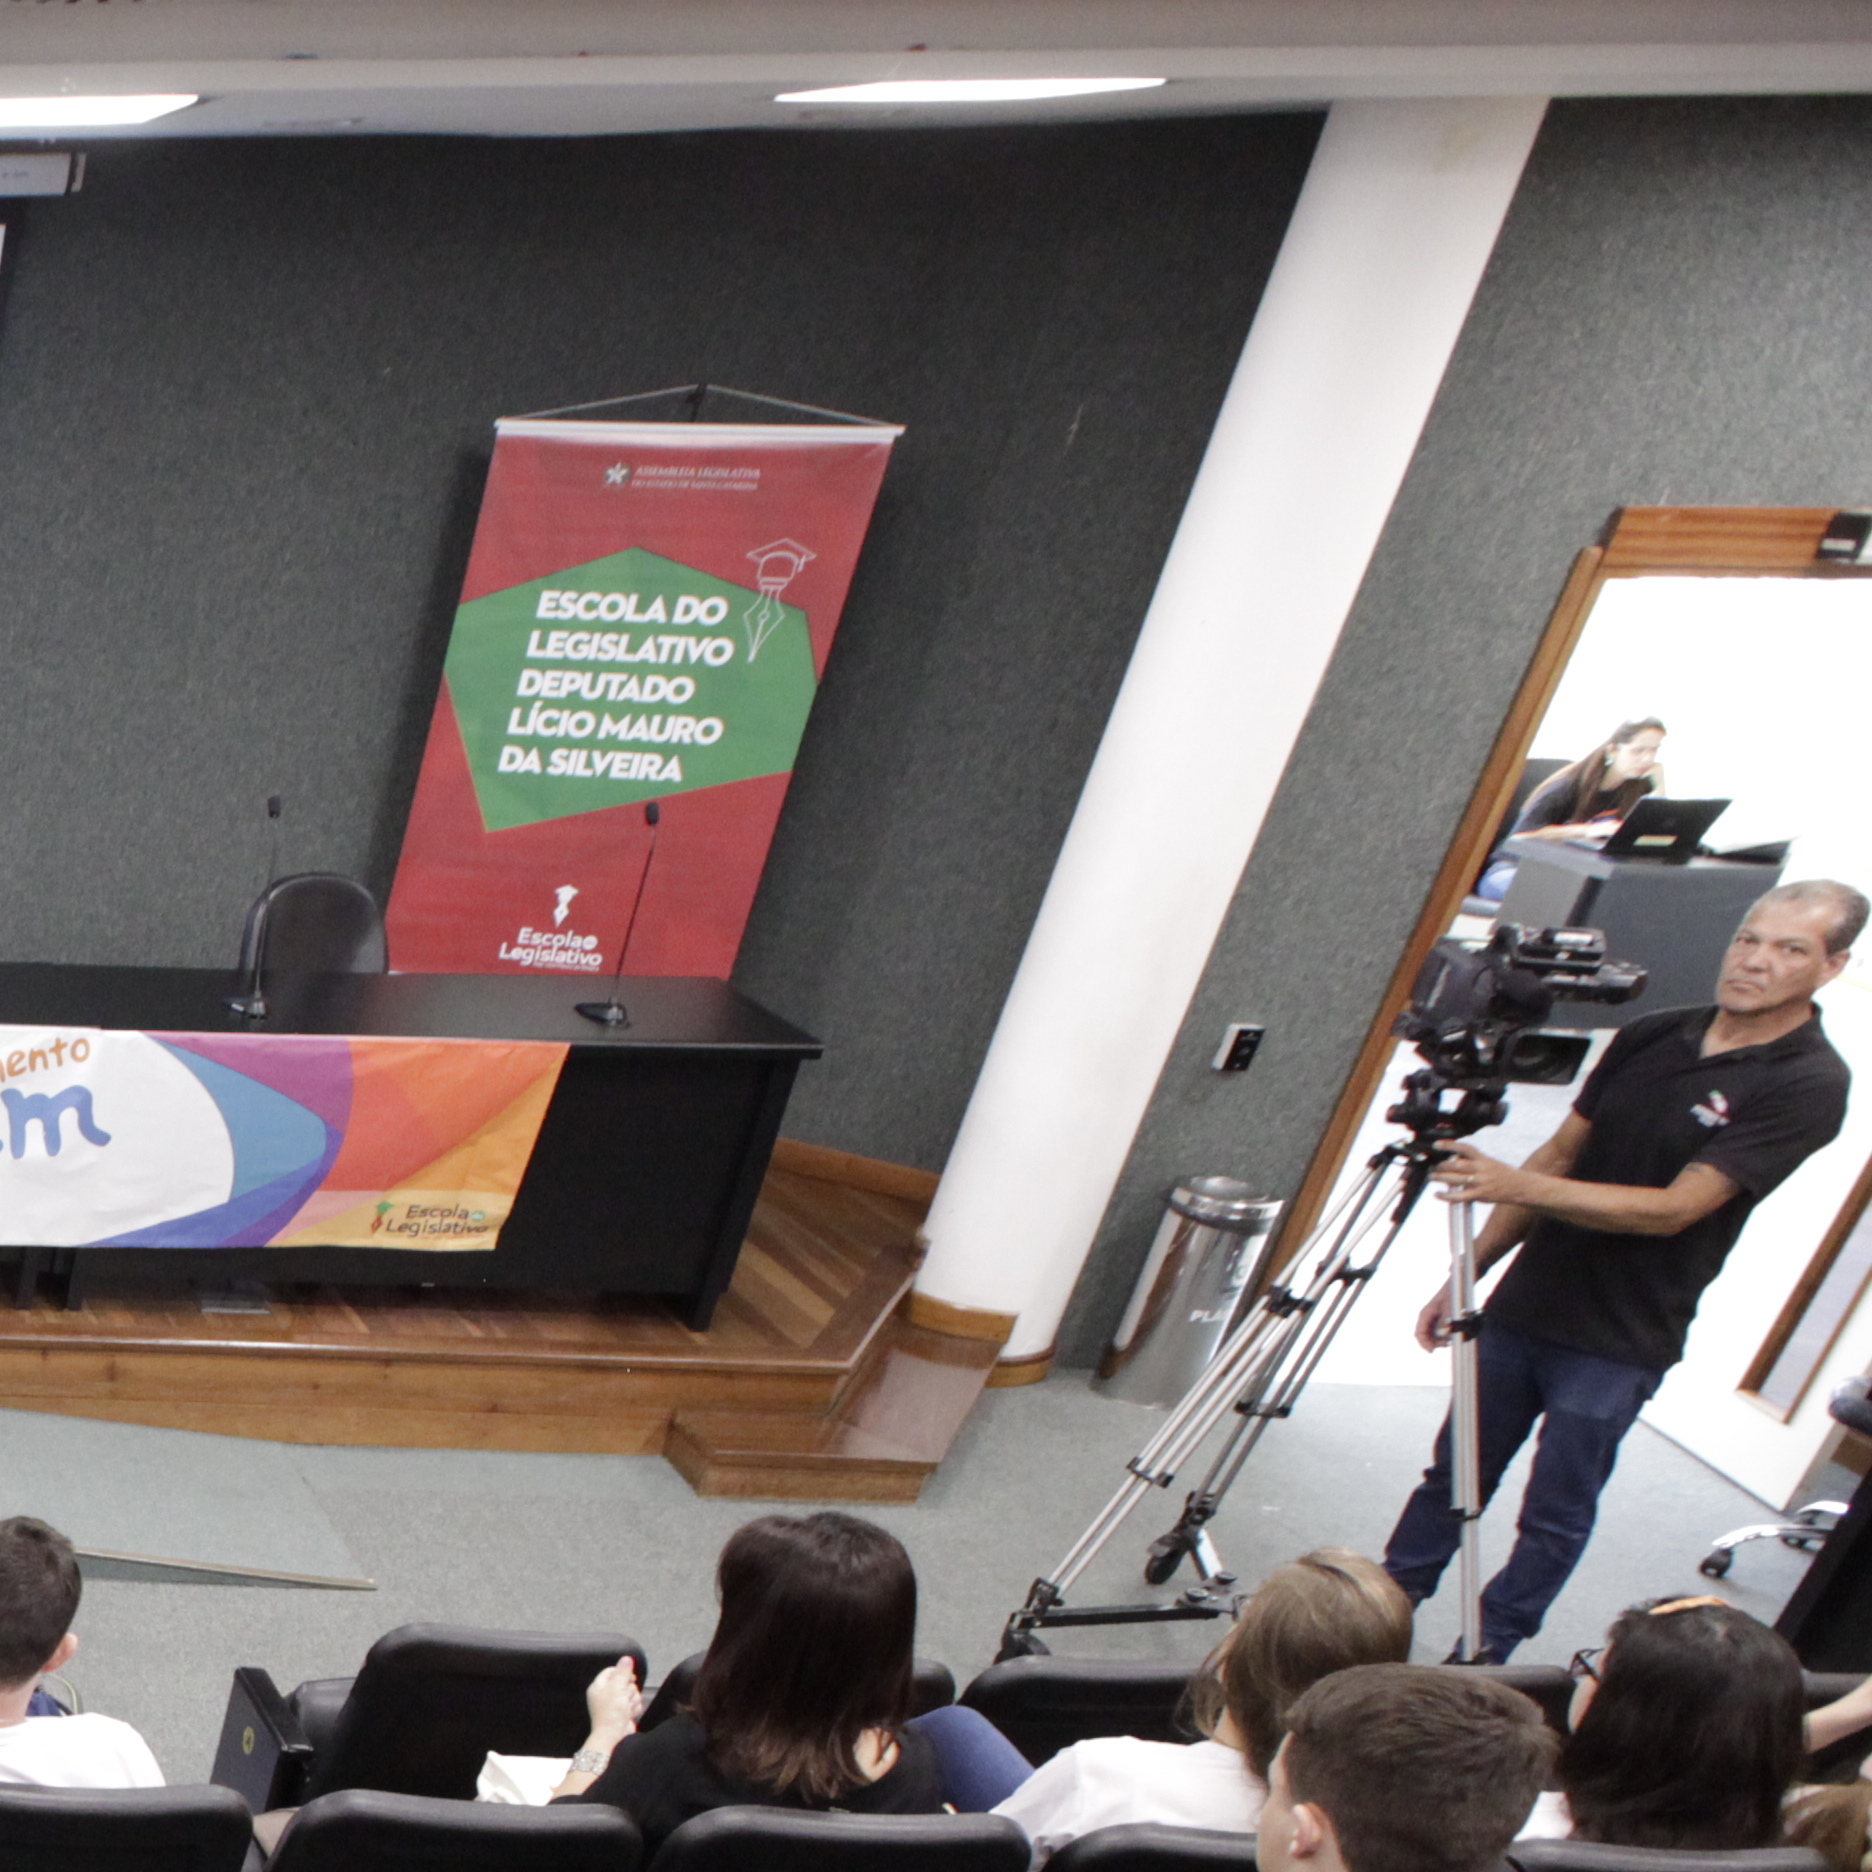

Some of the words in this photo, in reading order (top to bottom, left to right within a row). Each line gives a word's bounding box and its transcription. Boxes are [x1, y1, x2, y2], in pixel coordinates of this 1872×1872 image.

[535, 589, 668, 624] ESCOLA
[671, 594, 730, 626] DO
[526, 629, 735, 667] LEGISLATIVO
[516, 668, 697, 705] DEPUTADO
[507, 700, 597, 739] LÍCIO
[597, 712, 725, 746] MAURO
[497, 744, 542, 775] DA
[547, 747, 683, 783] SILVEIRA
[498, 941, 604, 967] Legislativo
[517, 926, 583, 949] Escola
[385, 1218, 489, 1238] Legislativo
[406, 1203, 470, 1219] Escola
